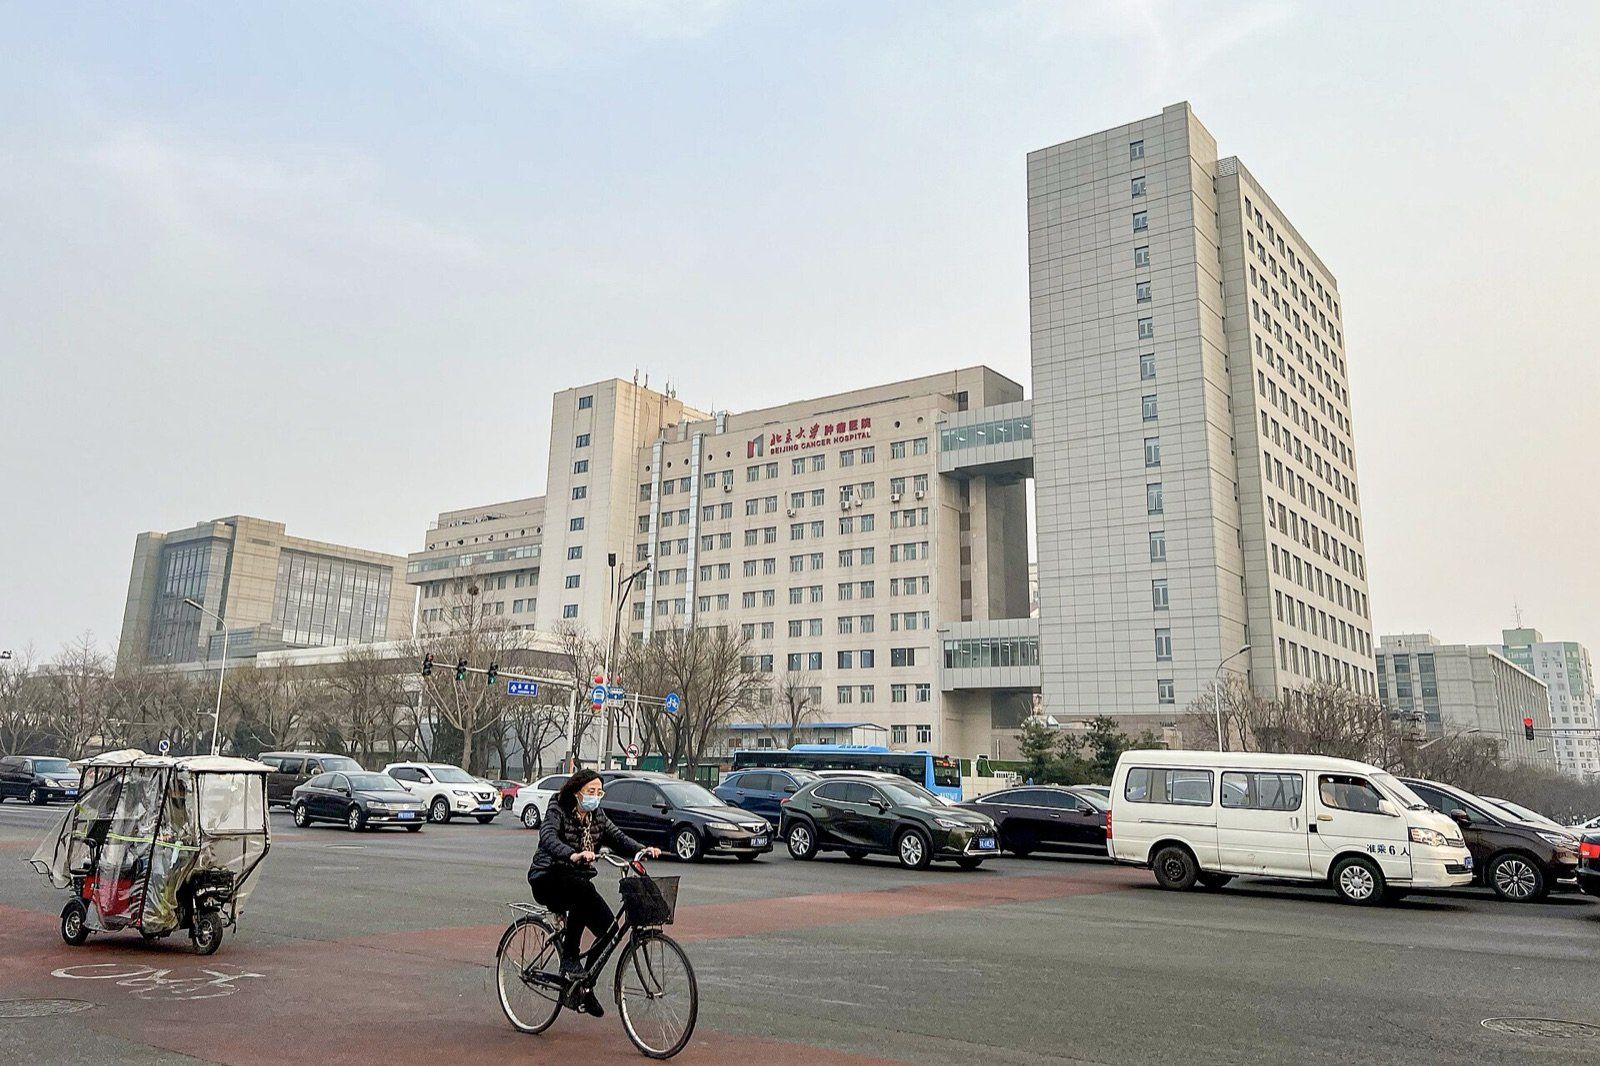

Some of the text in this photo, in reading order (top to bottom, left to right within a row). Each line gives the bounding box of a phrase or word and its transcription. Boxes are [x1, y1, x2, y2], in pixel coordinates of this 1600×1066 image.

[770, 432, 871, 454] BEIJING CANCER HOSPITAL
